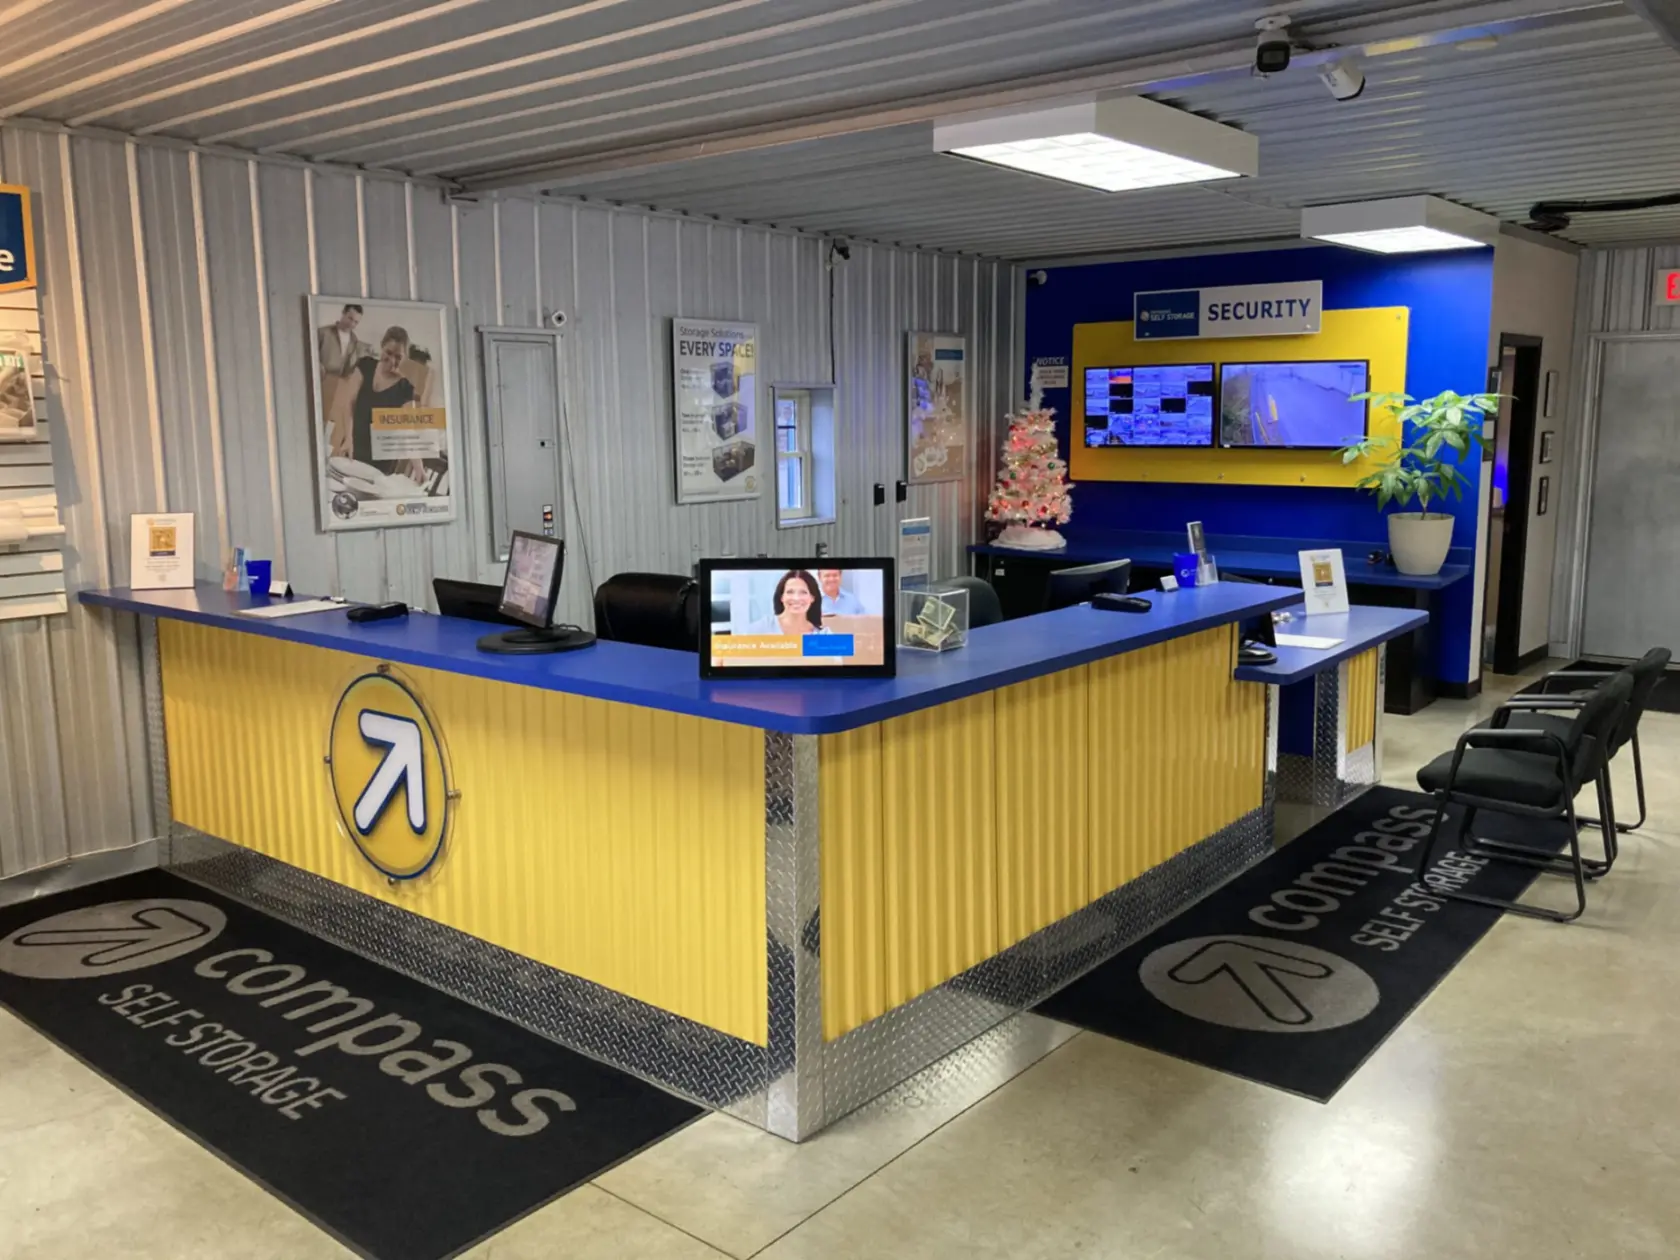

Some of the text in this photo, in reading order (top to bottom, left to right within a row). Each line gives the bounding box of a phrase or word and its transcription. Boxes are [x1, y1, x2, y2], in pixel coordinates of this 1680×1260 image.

[1207, 299, 1311, 321] SECURITY
[680, 326, 709, 338] Storage
[711, 328, 744, 339] Solutions
[680, 340, 755, 358] EVERY SPACE!
[380, 414, 434, 424] INSURANCE
[1248, 806, 1449, 930] compass
[1350, 907, 1425, 951] SELF
[98, 984, 348, 1120] SELF STORAGE
[193, 948, 577, 1137] compass
